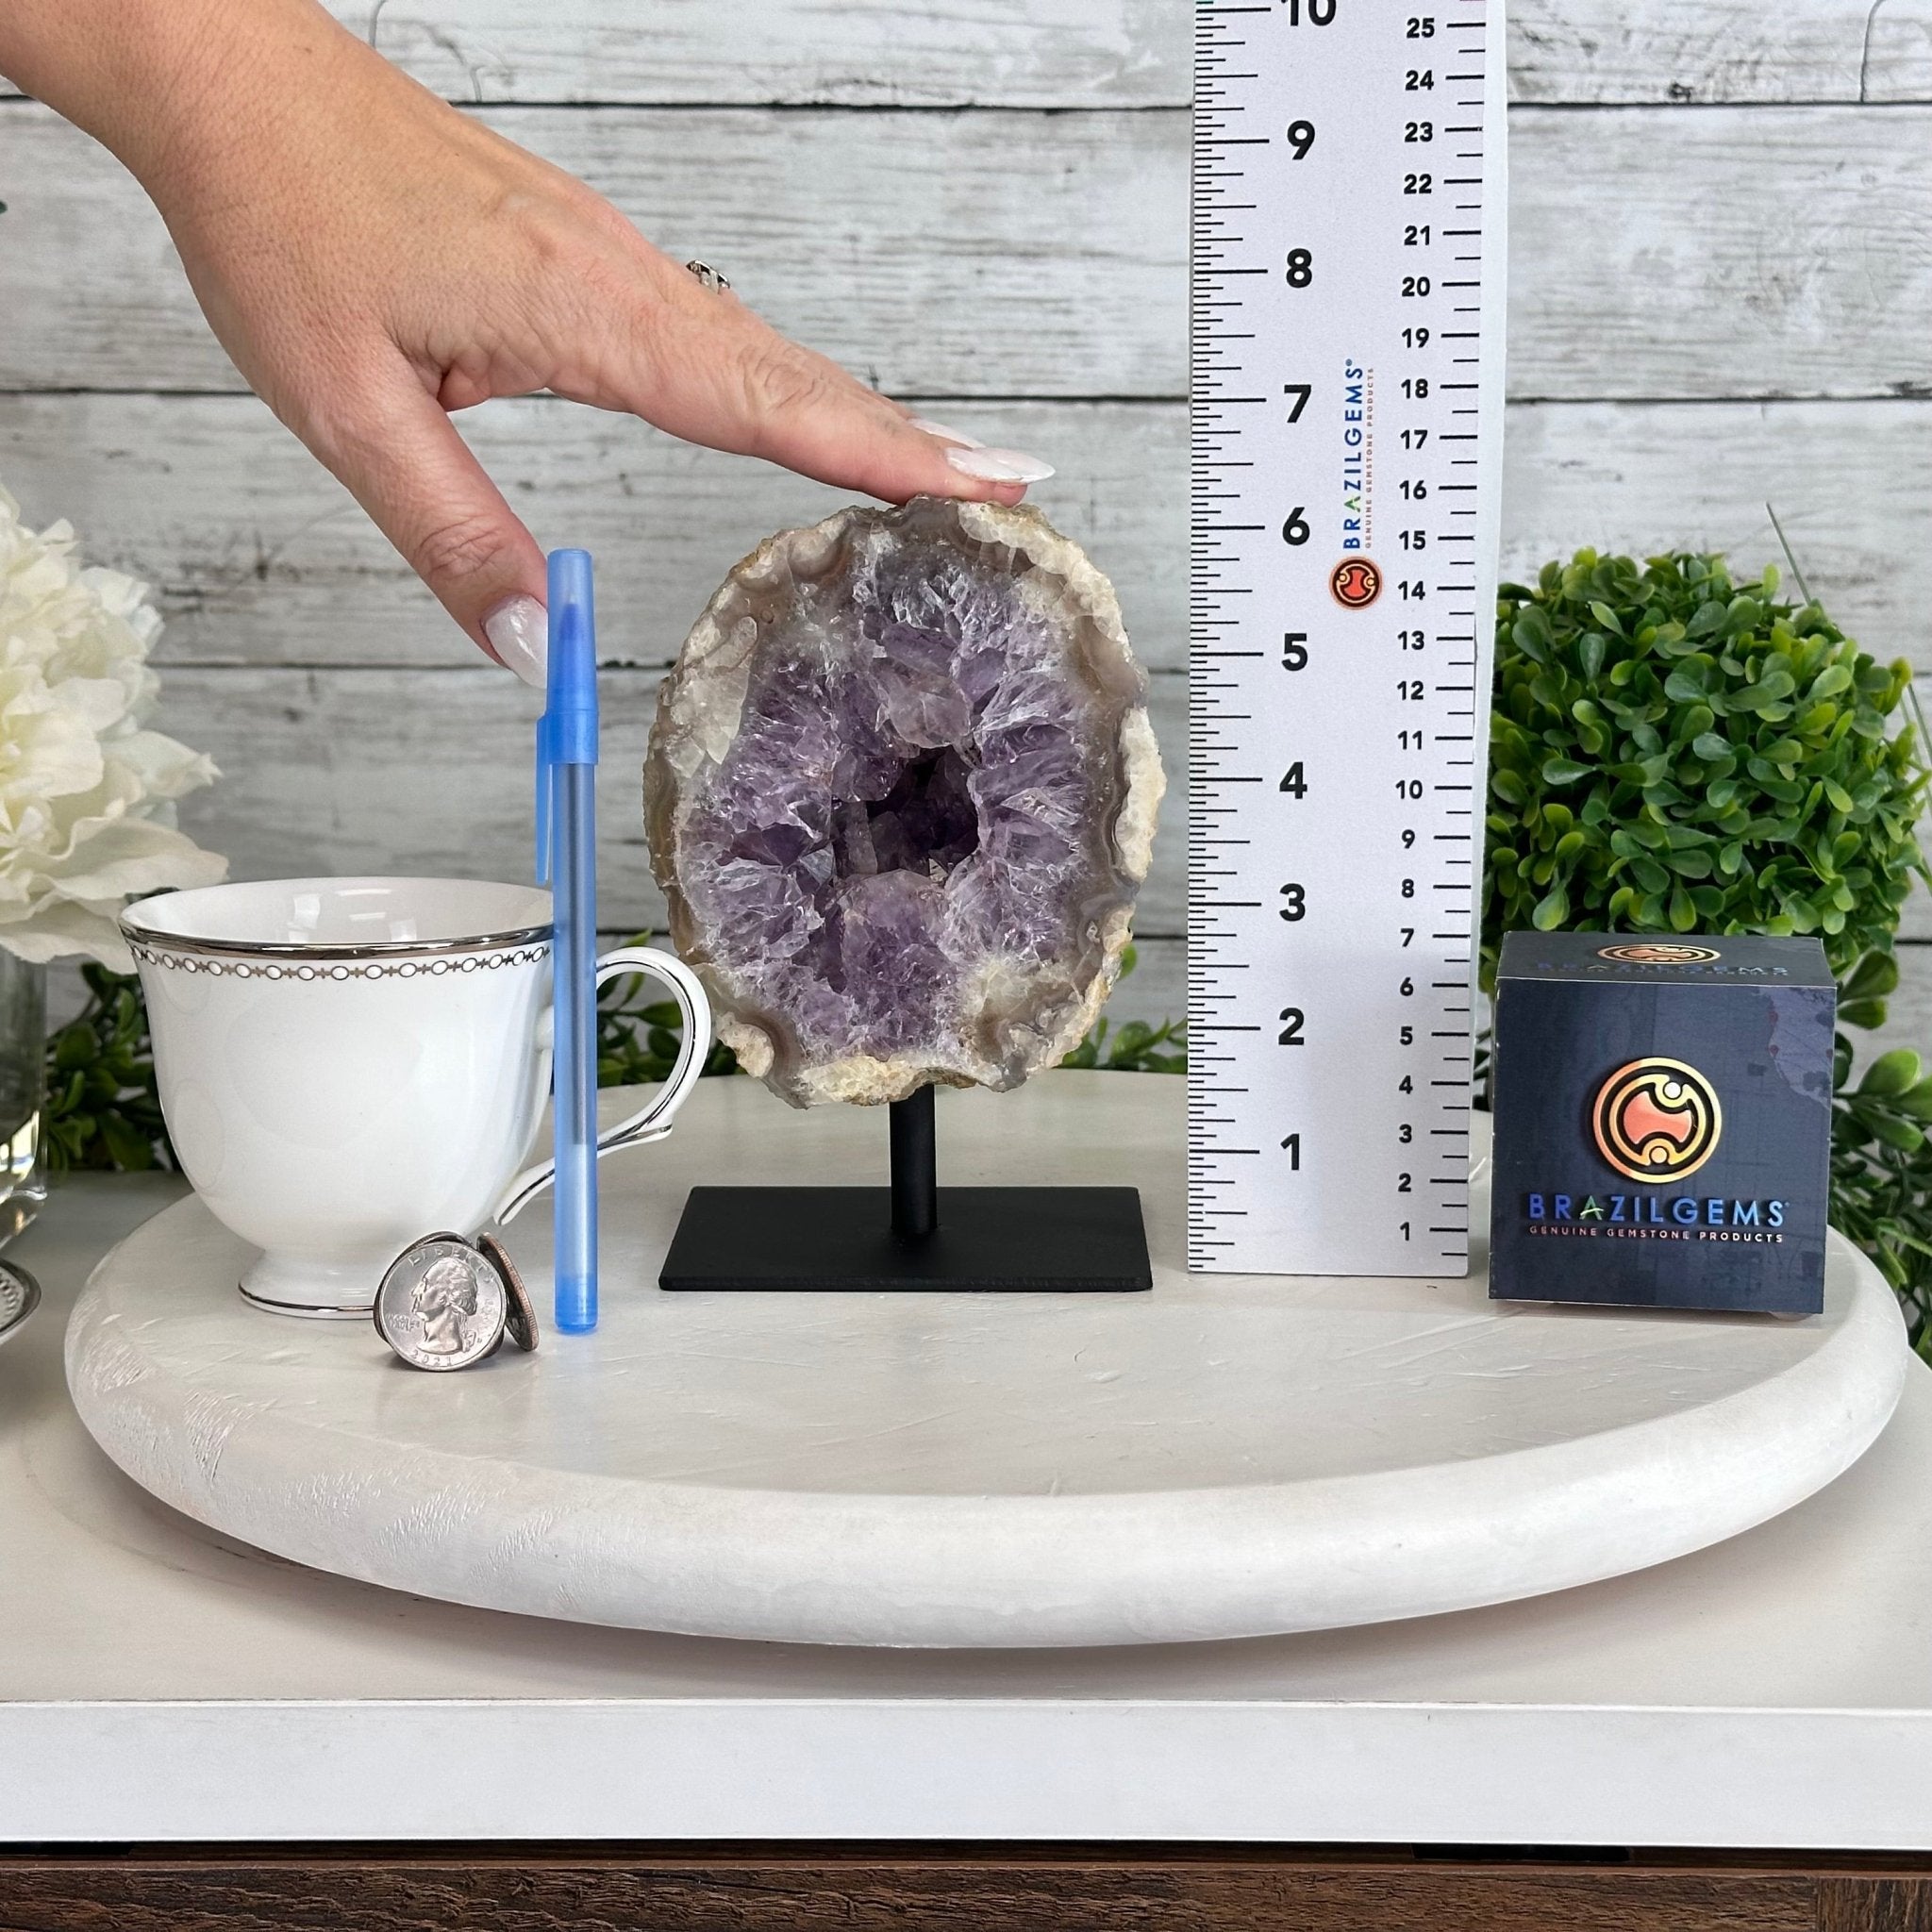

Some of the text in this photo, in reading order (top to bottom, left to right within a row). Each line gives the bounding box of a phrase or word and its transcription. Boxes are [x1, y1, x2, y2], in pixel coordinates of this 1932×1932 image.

[1280, 0, 1337, 27] 10
[1406, 17, 1435, 39] 25
[1405, 69, 1435, 92] 24
[1287, 120, 1316, 160] 9
[1404, 121, 1433, 143] 23
[1403, 173, 1432, 195] 22
[1404, 225, 1430, 246] 21
[1286, 248, 1313, 289] 8
[1401, 276, 1431, 297] 20
[1401, 327, 1430, 349] 19
[1401, 378, 1428, 399] 18
[1283, 384, 1312, 424] 7
[1400, 429, 1428, 450] 17
[1399, 479, 1427, 500] 16
[1282, 507, 1310, 546] 6
[1398, 530, 1426, 551] 15
[1397, 580, 1426, 601] 14
[1397, 630, 1424, 651] 13
[1281, 632, 1308, 672] 5
[1396, 680, 1424, 701] 12
[1397, 730, 1423, 750] 11
[1279, 761, 1308, 800] 4
[1395, 779, 1424, 800] 10
[1401, 829, 1416, 849] 9
[1401, 878, 1415, 899] 8
[1279, 883, 1306, 923] 3
[1400, 927, 1415, 948] 7
[1399, 976, 1414, 997] 6
[1278, 1007, 1305, 1046] 2
[1399, 1025, 1413, 1046] 5
[1398, 1074, 1414, 1095] 4
[1398, 1124, 1413, 1144] 3
[1280, 1133, 1300, 1171] 1
[1397, 1172, 1412, 1193] 2
[1399, 1221, 1410, 1241] 1
[1529, 1224, 1784, 1243] GENUINE GEMSTONE PRODUCTS
